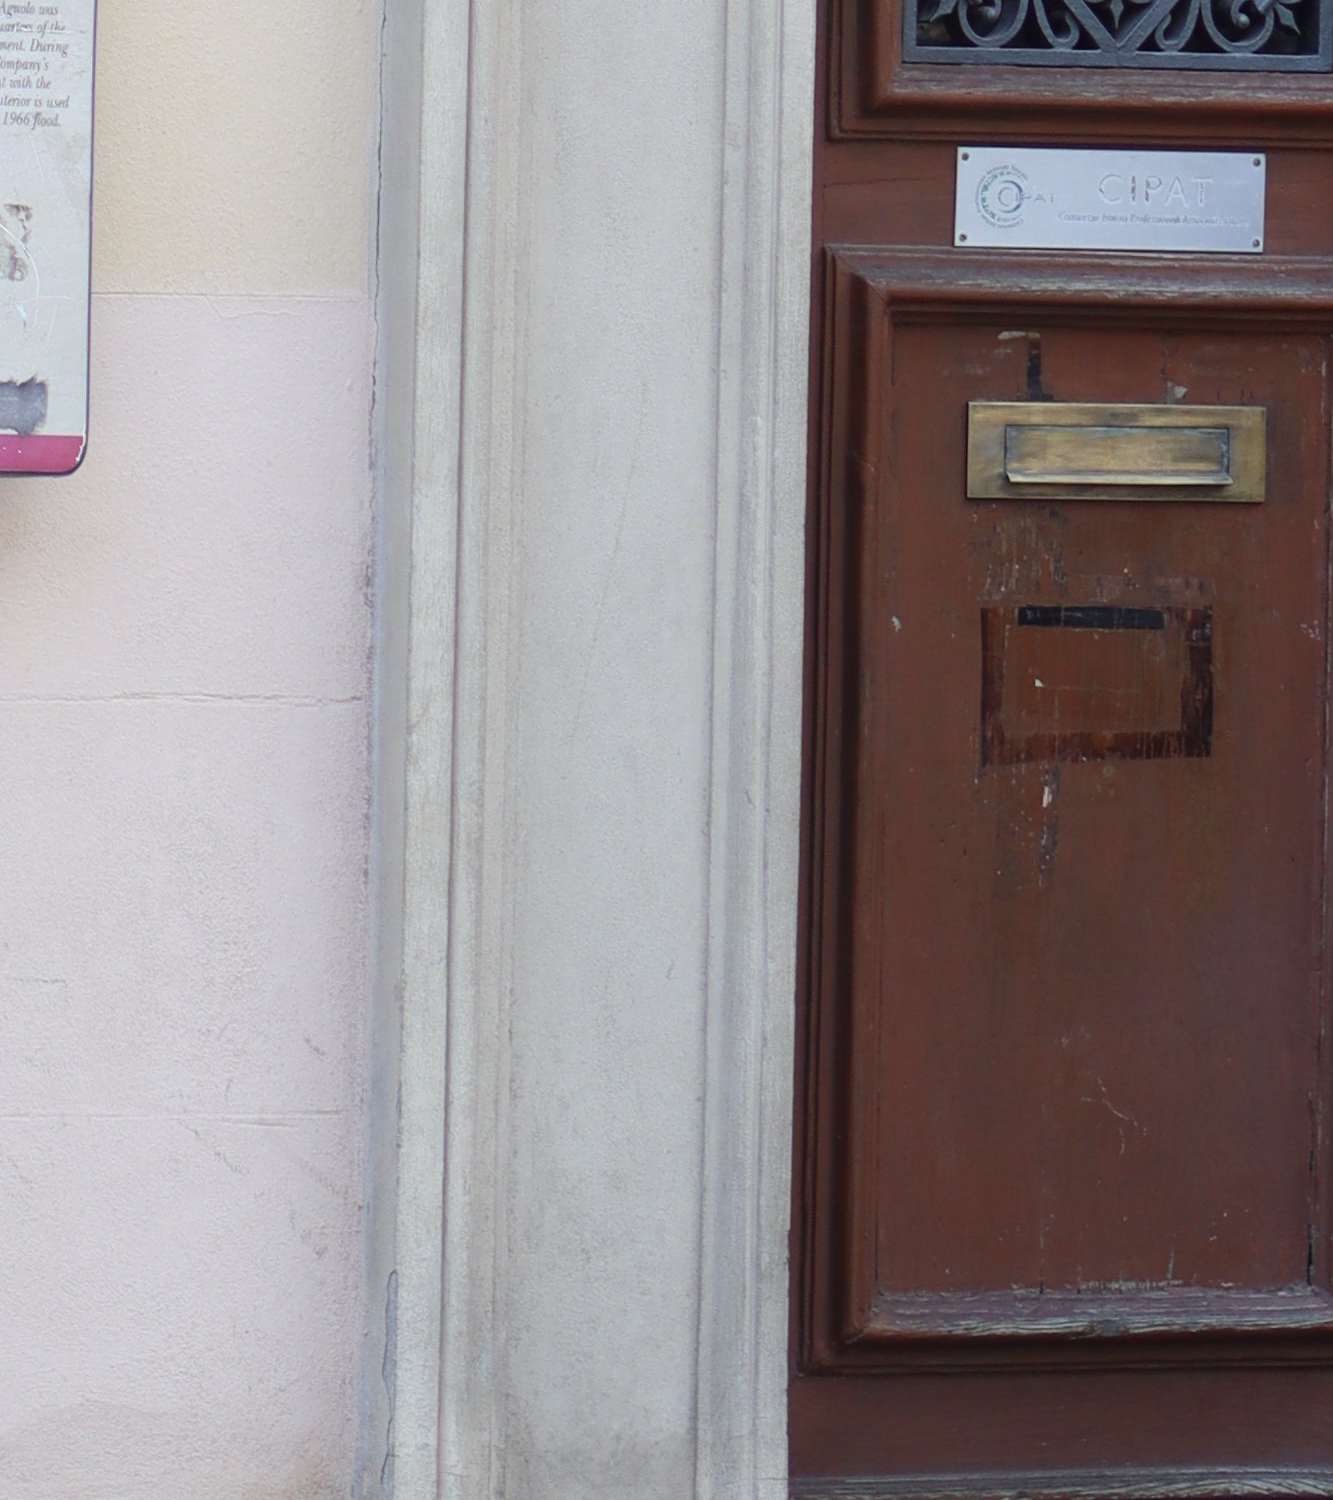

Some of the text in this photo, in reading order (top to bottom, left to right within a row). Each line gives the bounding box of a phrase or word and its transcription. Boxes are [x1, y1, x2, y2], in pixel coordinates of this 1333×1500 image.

[39, 5, 59, 16] was
[37, 20, 47, 38] of
[30, 38, 69, 57] During
[0, 56, 49, 74] ompany's
[9, 75, 32, 89] with
[35, 76, 52, 89] the
[34, 94, 42, 108] is
[47, 95, 70, 109] used
[3, 112, 30, 126] 1966
[1098, 173, 1214, 207] CIPAT
